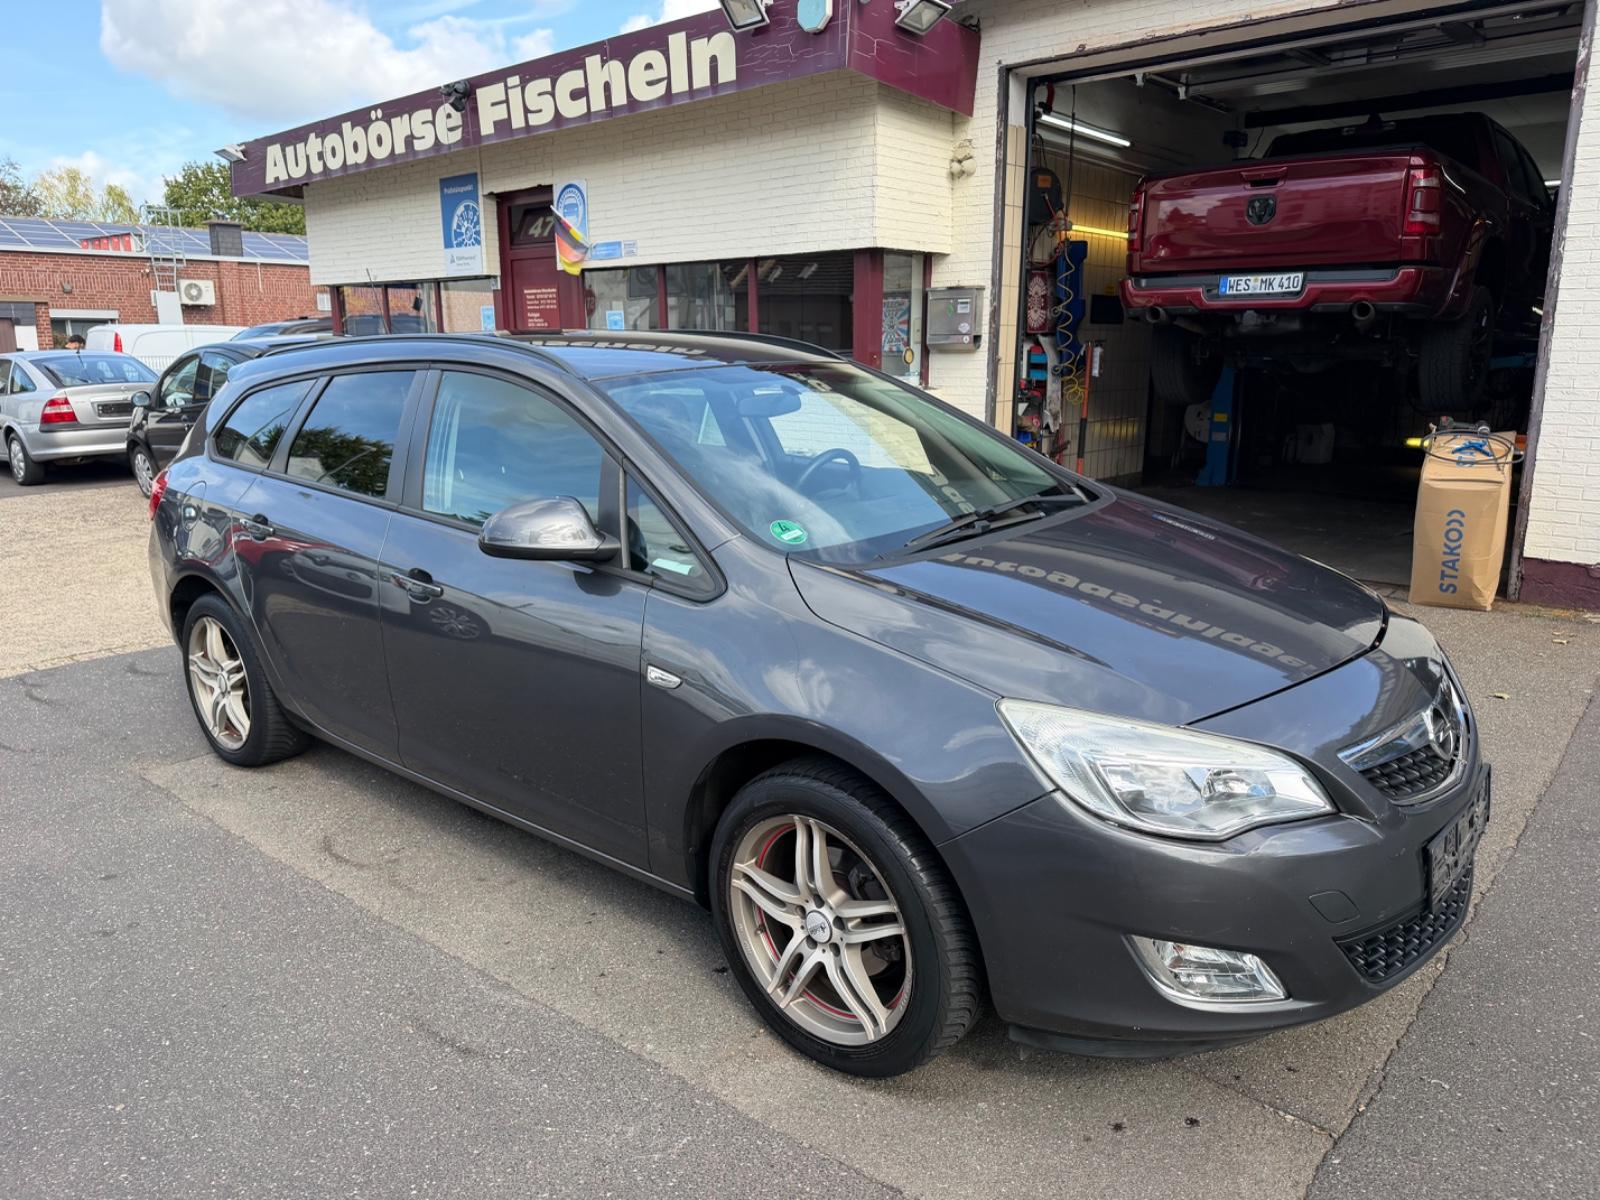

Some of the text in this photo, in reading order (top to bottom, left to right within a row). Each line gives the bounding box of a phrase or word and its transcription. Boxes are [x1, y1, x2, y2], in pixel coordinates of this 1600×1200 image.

[264, 31, 737, 184] Autobörse Fischeln
[529, 216, 554, 238] 47
[1228, 275, 1300, 292] WES MK 410
